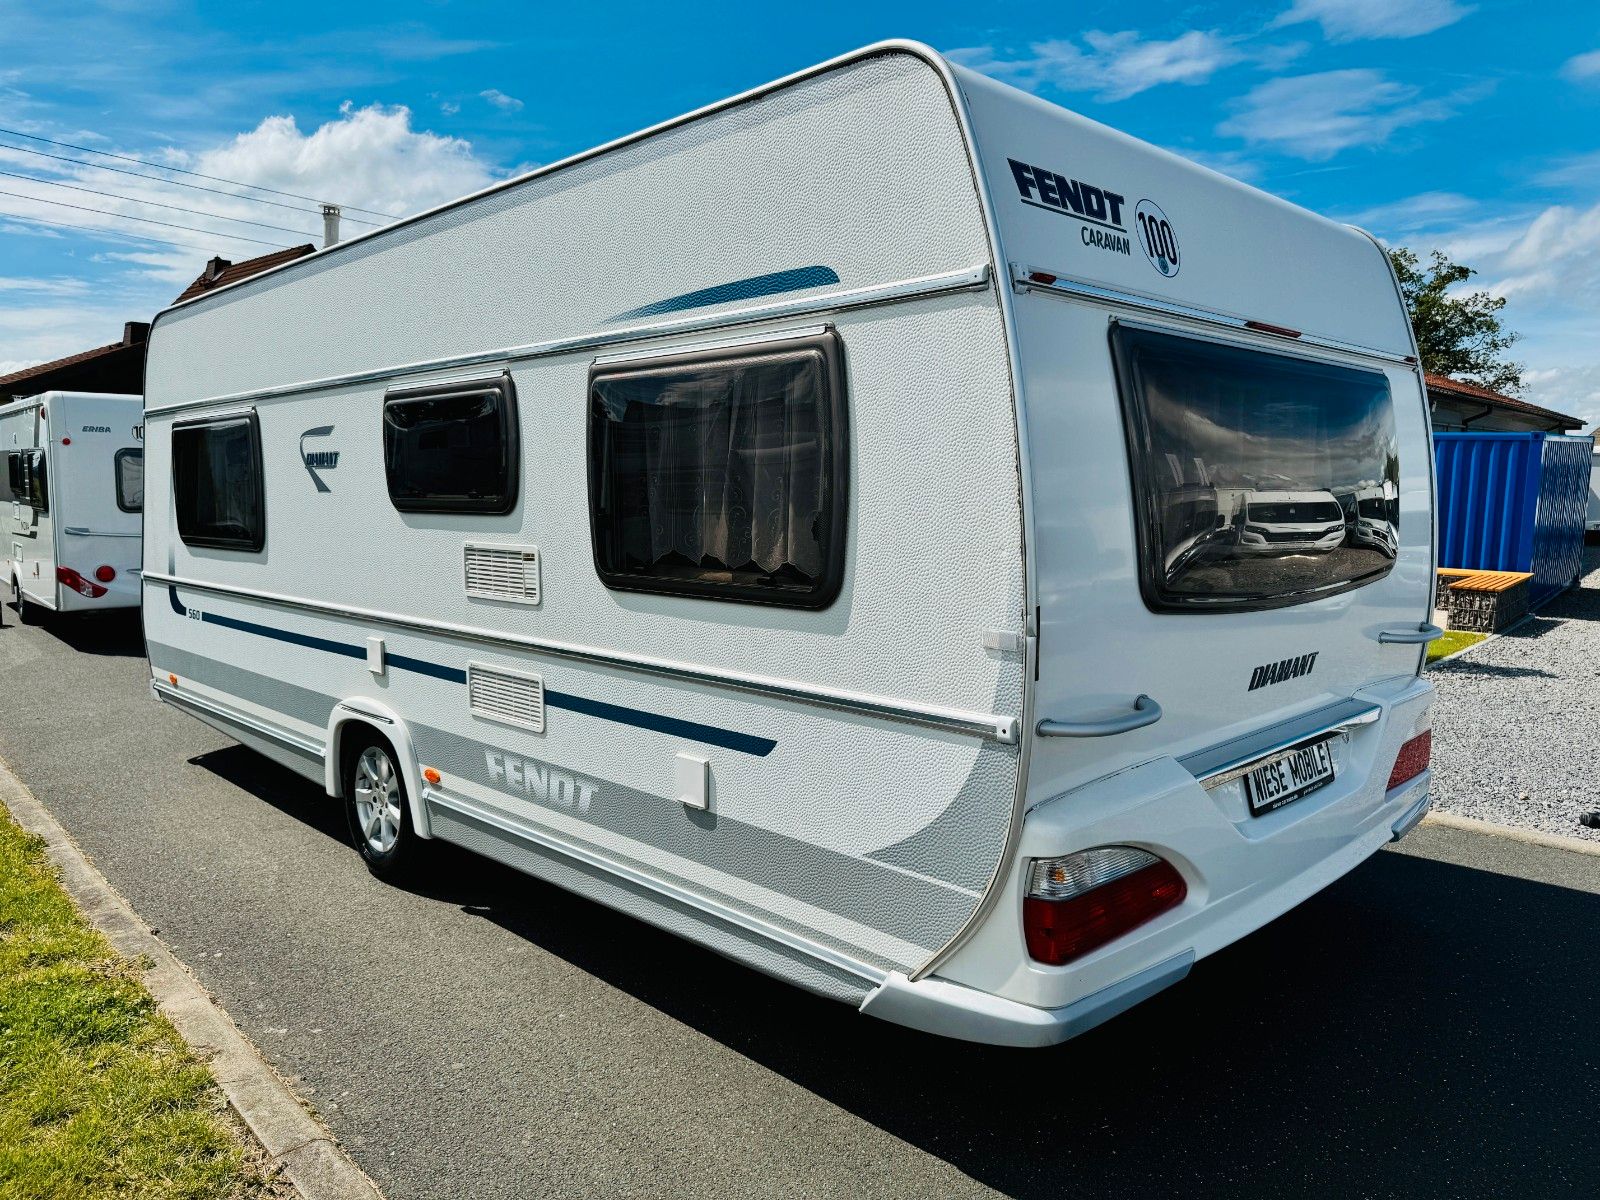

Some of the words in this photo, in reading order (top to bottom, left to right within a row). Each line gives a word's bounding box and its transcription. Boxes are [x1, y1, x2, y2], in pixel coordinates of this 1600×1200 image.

[1007, 158, 1125, 226] FENDT
[1080, 226, 1131, 256] CARAVAN
[1137, 211, 1178, 265] 100
[82, 425, 112, 434] ERIBA
[132, 425, 143, 440] 10
[188, 608, 201, 621] 560
[1247, 651, 1320, 692] DIAMANT
[484, 750, 600, 815] FENDT
[1252, 760, 1289, 803] NIESE
[1287, 743, 1329, 787] MOBILE
